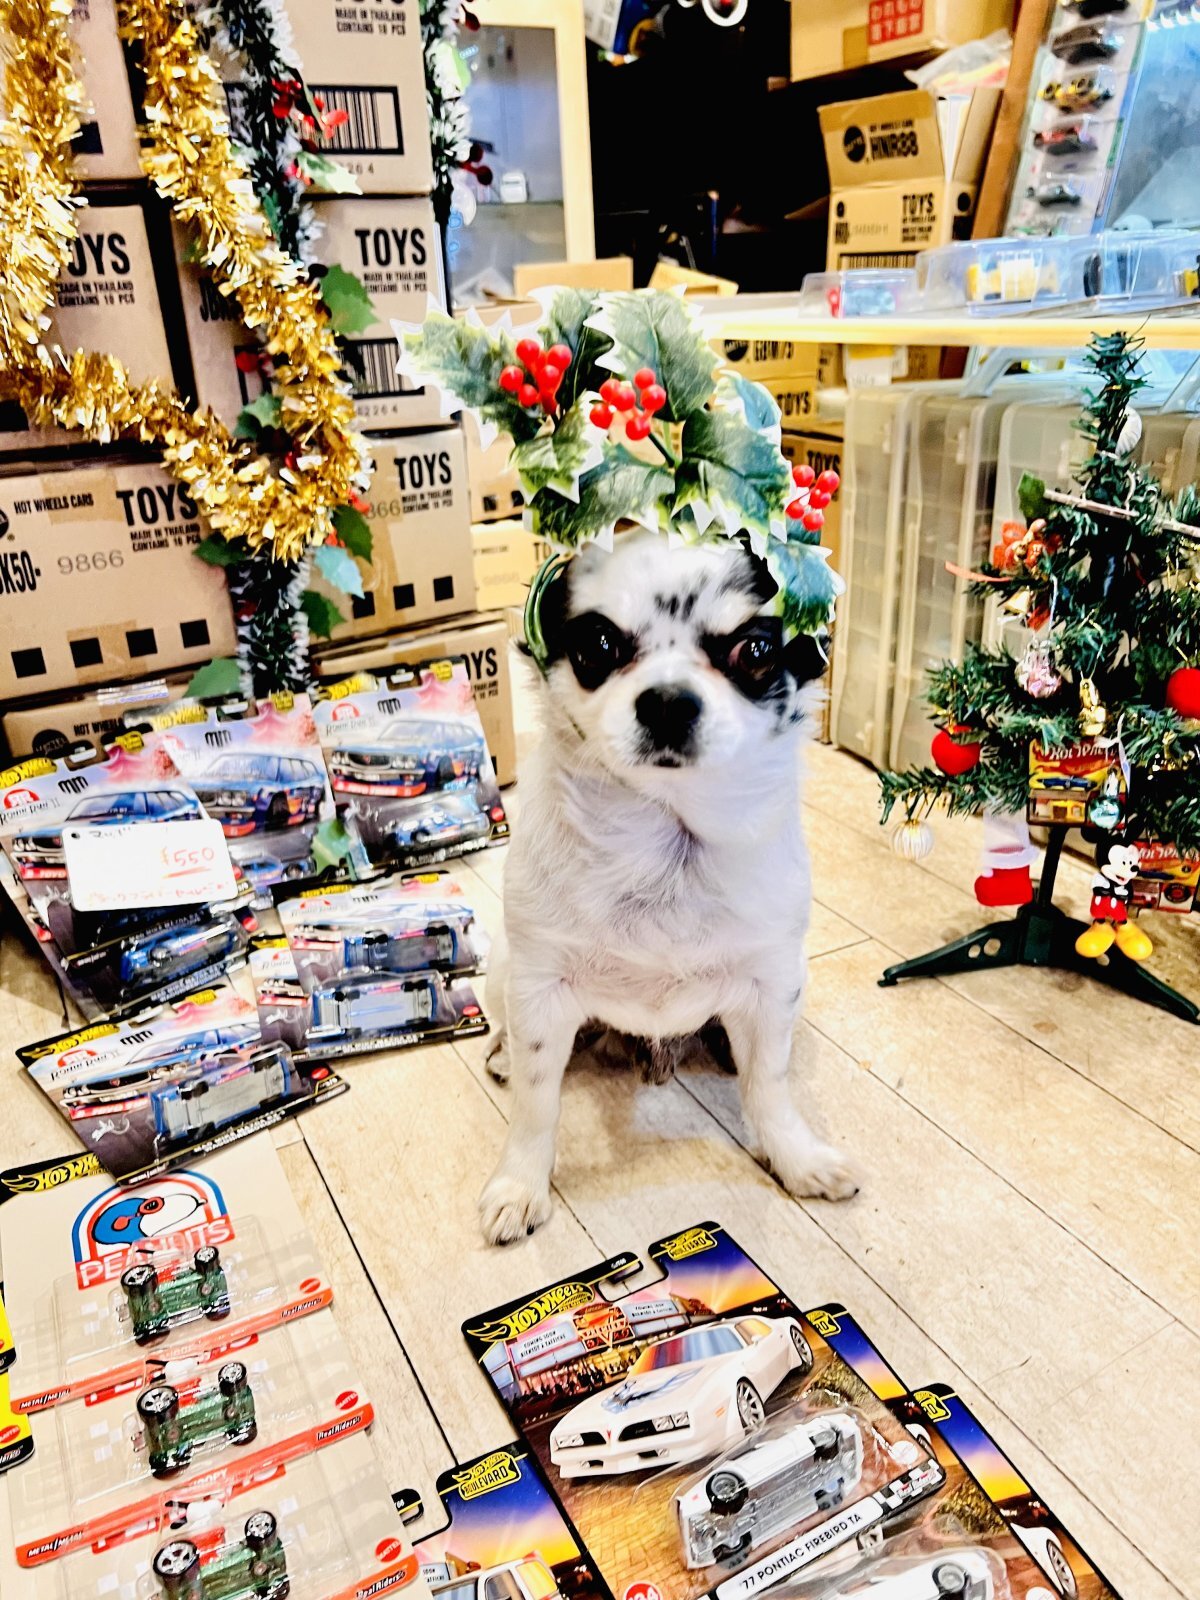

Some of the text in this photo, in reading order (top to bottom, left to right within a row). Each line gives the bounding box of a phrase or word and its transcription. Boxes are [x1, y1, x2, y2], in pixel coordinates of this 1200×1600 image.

[902, 192, 934, 215] TOYS
[60, 233, 131, 278] OYS
[354, 227, 427, 267] TOYS
[777, 390, 811, 416] TOYS
[393, 451, 452, 491] TOYS
[14, 493, 95, 514] HOT WHEELS CARS
[115, 481, 199, 527] TOYS
[130, 529, 152, 541] MADE
[154, 528, 163, 538] IN
[57, 549, 125, 576] 9866
[73, 723, 91, 737] HOT
[79, 1219, 231, 1287] PEANUTS
[463, 1465, 509, 1494] BOULEVARD
[757, 1547, 805, 1581] PONTIAC
[804, 1522, 849, 1553] FIREBIRD
[847, 1513, 863, 1525] TA
